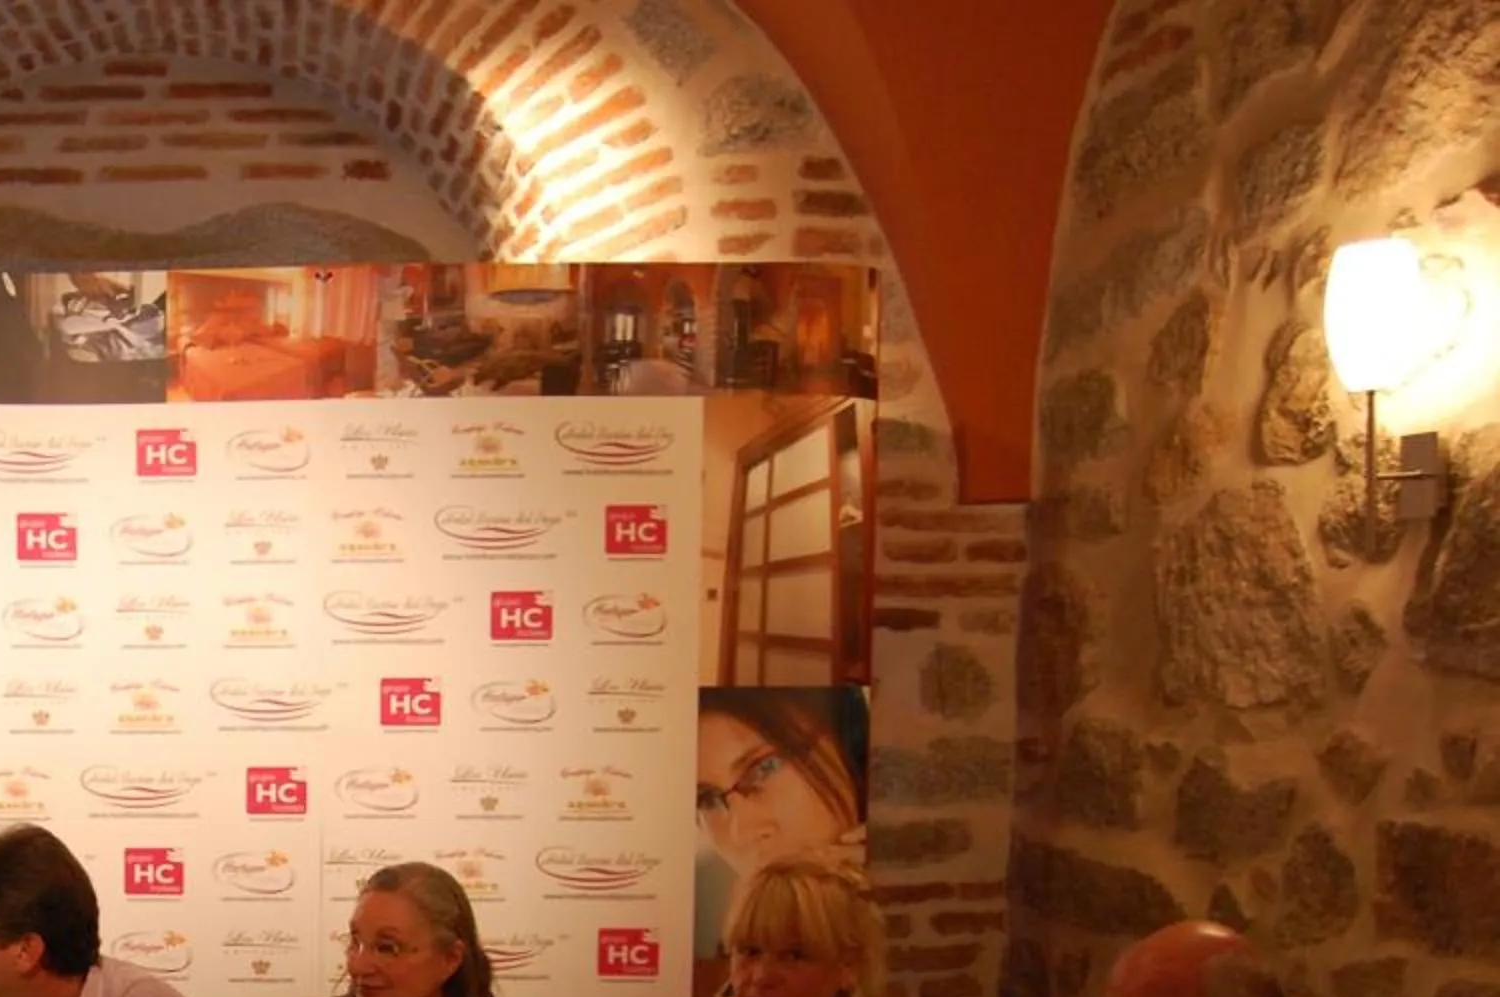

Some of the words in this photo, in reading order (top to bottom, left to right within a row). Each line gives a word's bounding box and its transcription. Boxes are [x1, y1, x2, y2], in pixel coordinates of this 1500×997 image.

[146, 444, 187, 465] HC
[26, 529, 69, 550] HC
[615, 522, 657, 542] HC
[500, 607, 542, 628] HC
[389, 694, 431, 715] HC
[256, 783, 297, 803] HC
[134, 863, 174, 884] HC
[607, 944, 649, 965] HC
